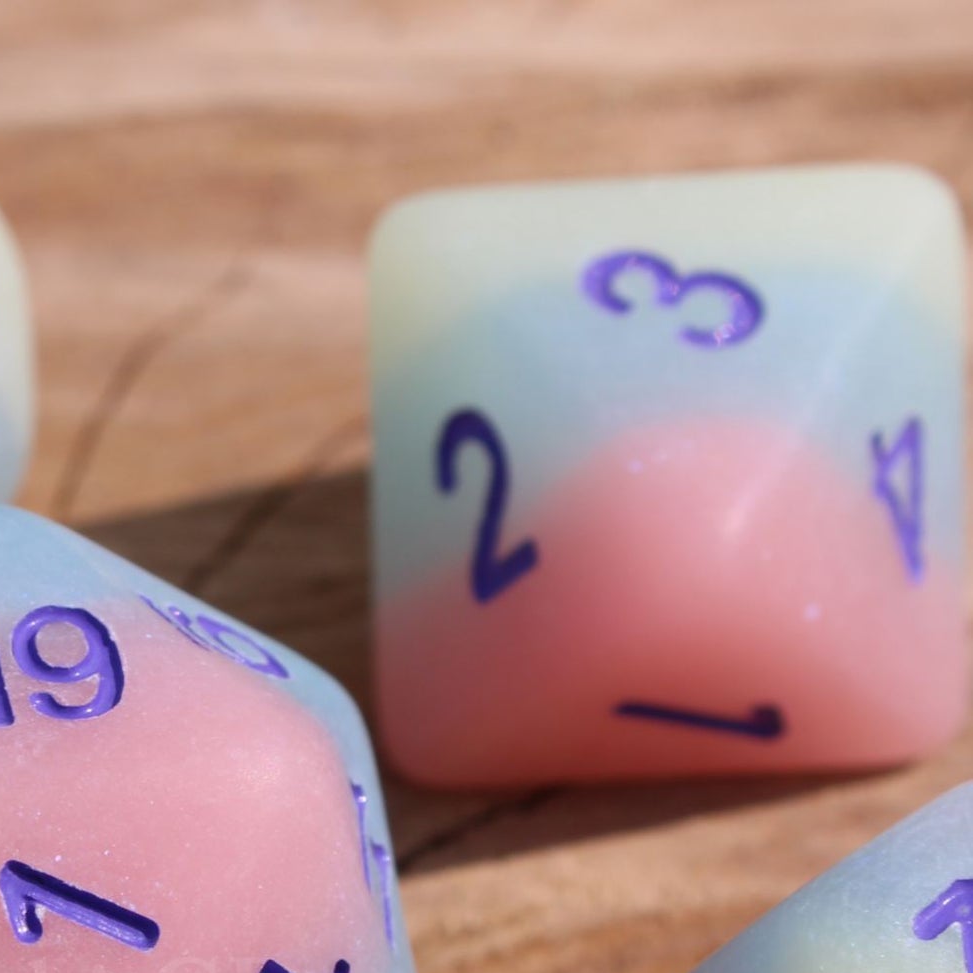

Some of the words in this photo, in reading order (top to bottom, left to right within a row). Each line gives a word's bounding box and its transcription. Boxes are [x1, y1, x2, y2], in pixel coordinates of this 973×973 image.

[581, 250, 765, 347] 3
[435, 408, 540, 605] 2
[869, 415, 924, 586] 4
[611, 698, 789, 743] 1
